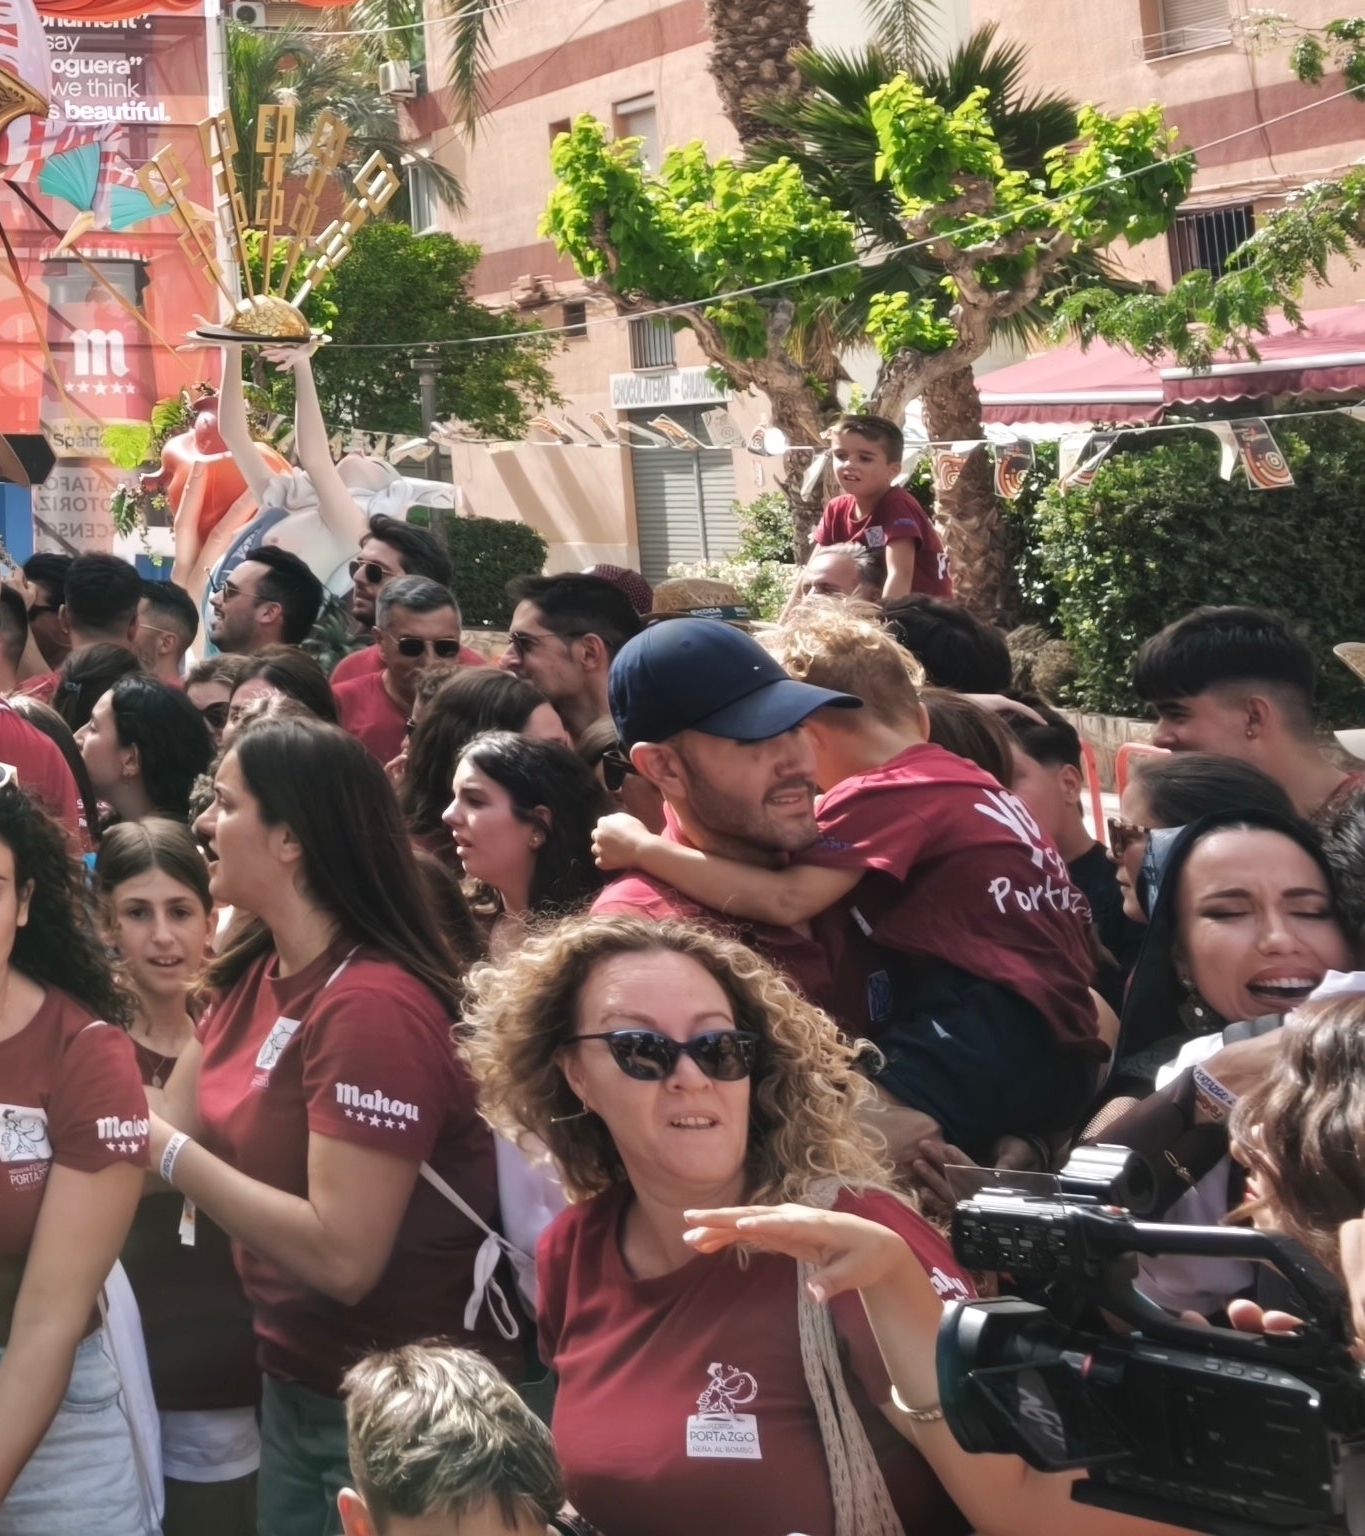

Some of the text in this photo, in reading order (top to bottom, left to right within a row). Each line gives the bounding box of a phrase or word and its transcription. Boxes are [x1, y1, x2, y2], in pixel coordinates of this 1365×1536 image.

[50, 56, 143, 78] oguera”
[51, 78, 141, 98] we think
[64, 100, 172, 122] beautiful.
[335, 1082, 420, 1122] Mahou
[689, 1430, 756, 1443] PORTAZGO
